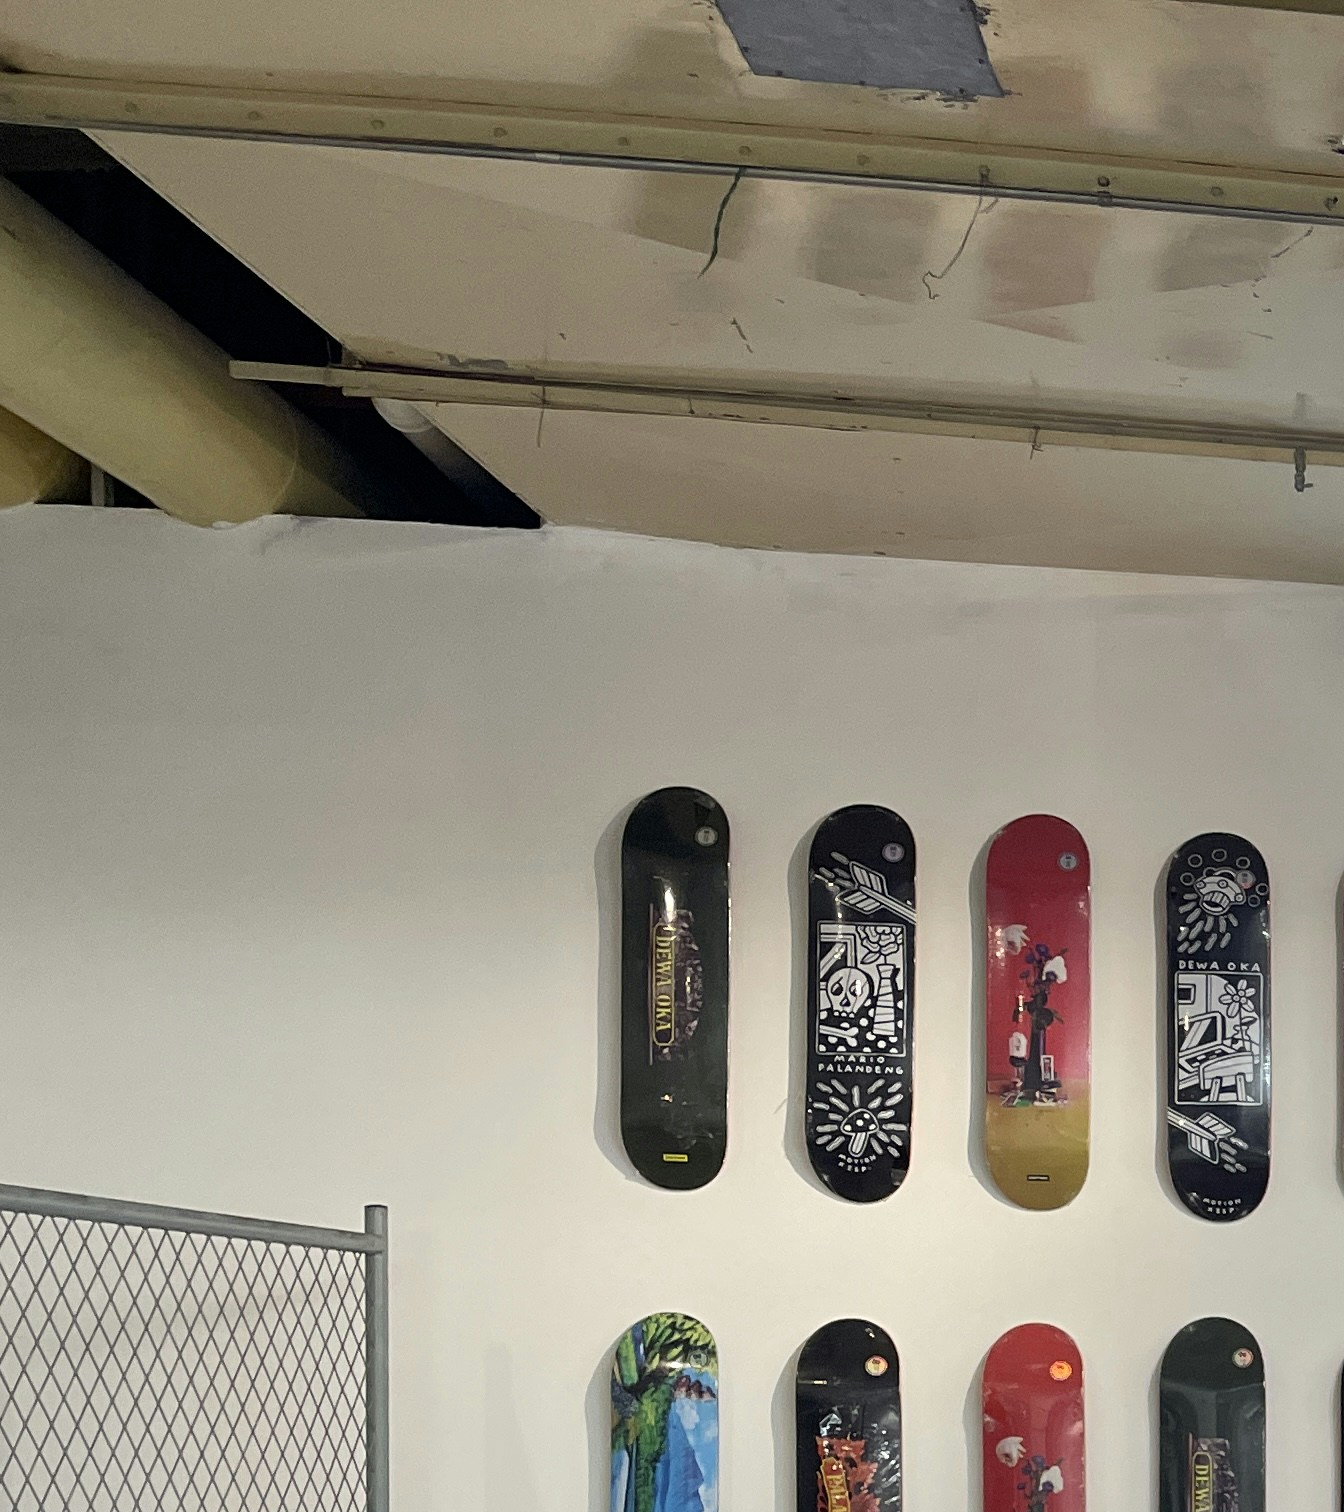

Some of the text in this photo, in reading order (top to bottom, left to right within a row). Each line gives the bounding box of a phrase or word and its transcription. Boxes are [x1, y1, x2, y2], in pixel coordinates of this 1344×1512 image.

[1178, 960, 1261, 972] DEWA OKA
[656, 935, 672, 1032] DEWA OKA
[834, 1055, 885, 1064] MARIO
[818, 1062, 904, 1075] PALANDENG
[1195, 1464, 1209, 1512] DEWA
